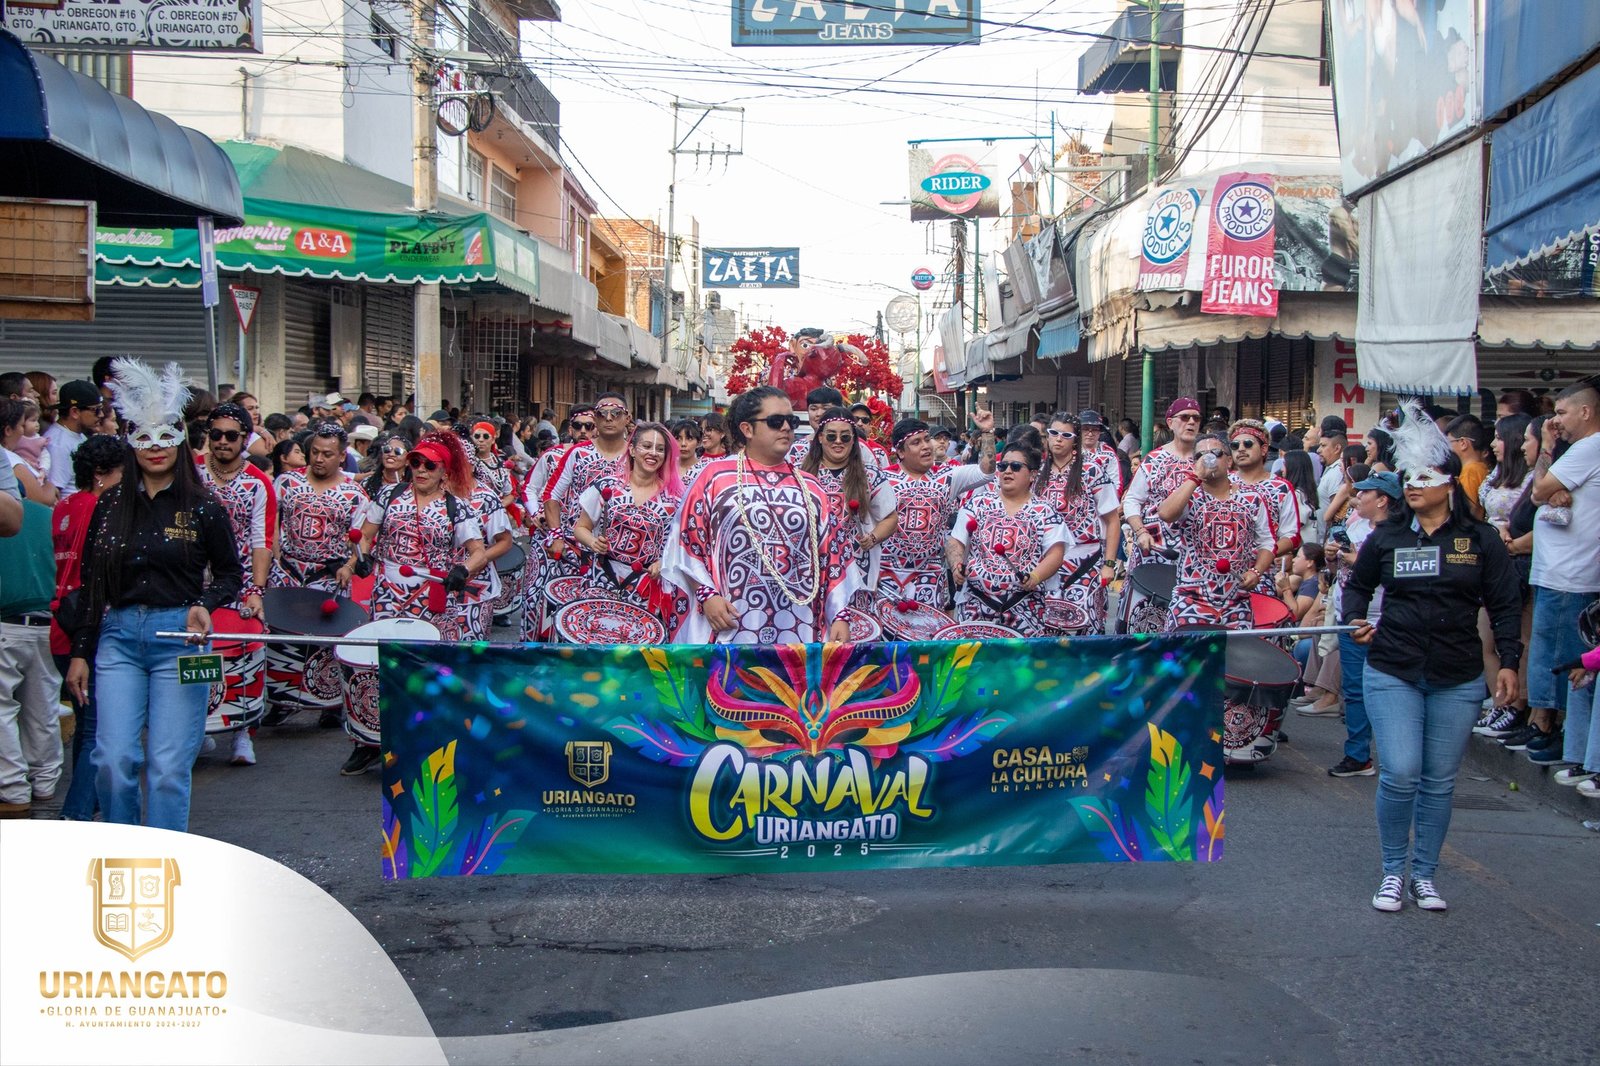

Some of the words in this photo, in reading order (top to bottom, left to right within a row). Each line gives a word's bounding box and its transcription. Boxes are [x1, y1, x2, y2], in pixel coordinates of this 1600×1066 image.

[67, 8, 117, 18] OBREGON
[120, 9, 136, 19] #16
[158, 10, 168, 20] C.
[170, 11, 220, 21] OBREGON
[222, 12, 238, 21] #57
[12, 19, 36, 29] GTO.
[52, 20, 113, 33] URIANGATO,
[115, 22, 139, 32] GTO.
[155, 23, 215, 35] URIANGATO,
[218, 24, 241, 34] GTO.
[819, 22, 894, 40] JEANS
[930, 176, 983, 191] RIDER
[1156, 189, 1192, 213] FUROR
[1226, 187, 1271, 202] FUROR
[1221, 207, 1273, 235] PRODUCTS
[1143, 216, 1191, 256] PRODUCTS
[389, 239, 456, 255] PLAYBOY
[709, 256, 793, 281] ZAETA
[1209, 254, 1274, 280] FUROR
[1140, 272, 1183, 290] FUROR
[1206, 280, 1273, 306] JEANS
[239, 301, 252, 311] PASO
[734, 488, 808, 505] BATAL
[1396, 560, 1436, 572] STAFF
[183, 668, 219, 681] STAFF
[992, 745, 1053, 769] CASA
[1055, 752, 1072, 765] DE
[991, 771, 1009, 784] LA
[1012, 763, 1088, 784] CULTURA
[690, 743, 933, 841] CARNAVAL
[991, 779, 1089, 793] URIANGATO
[542, 790, 636, 806] URIANGATO
[757, 813, 898, 844] URIANGATO
